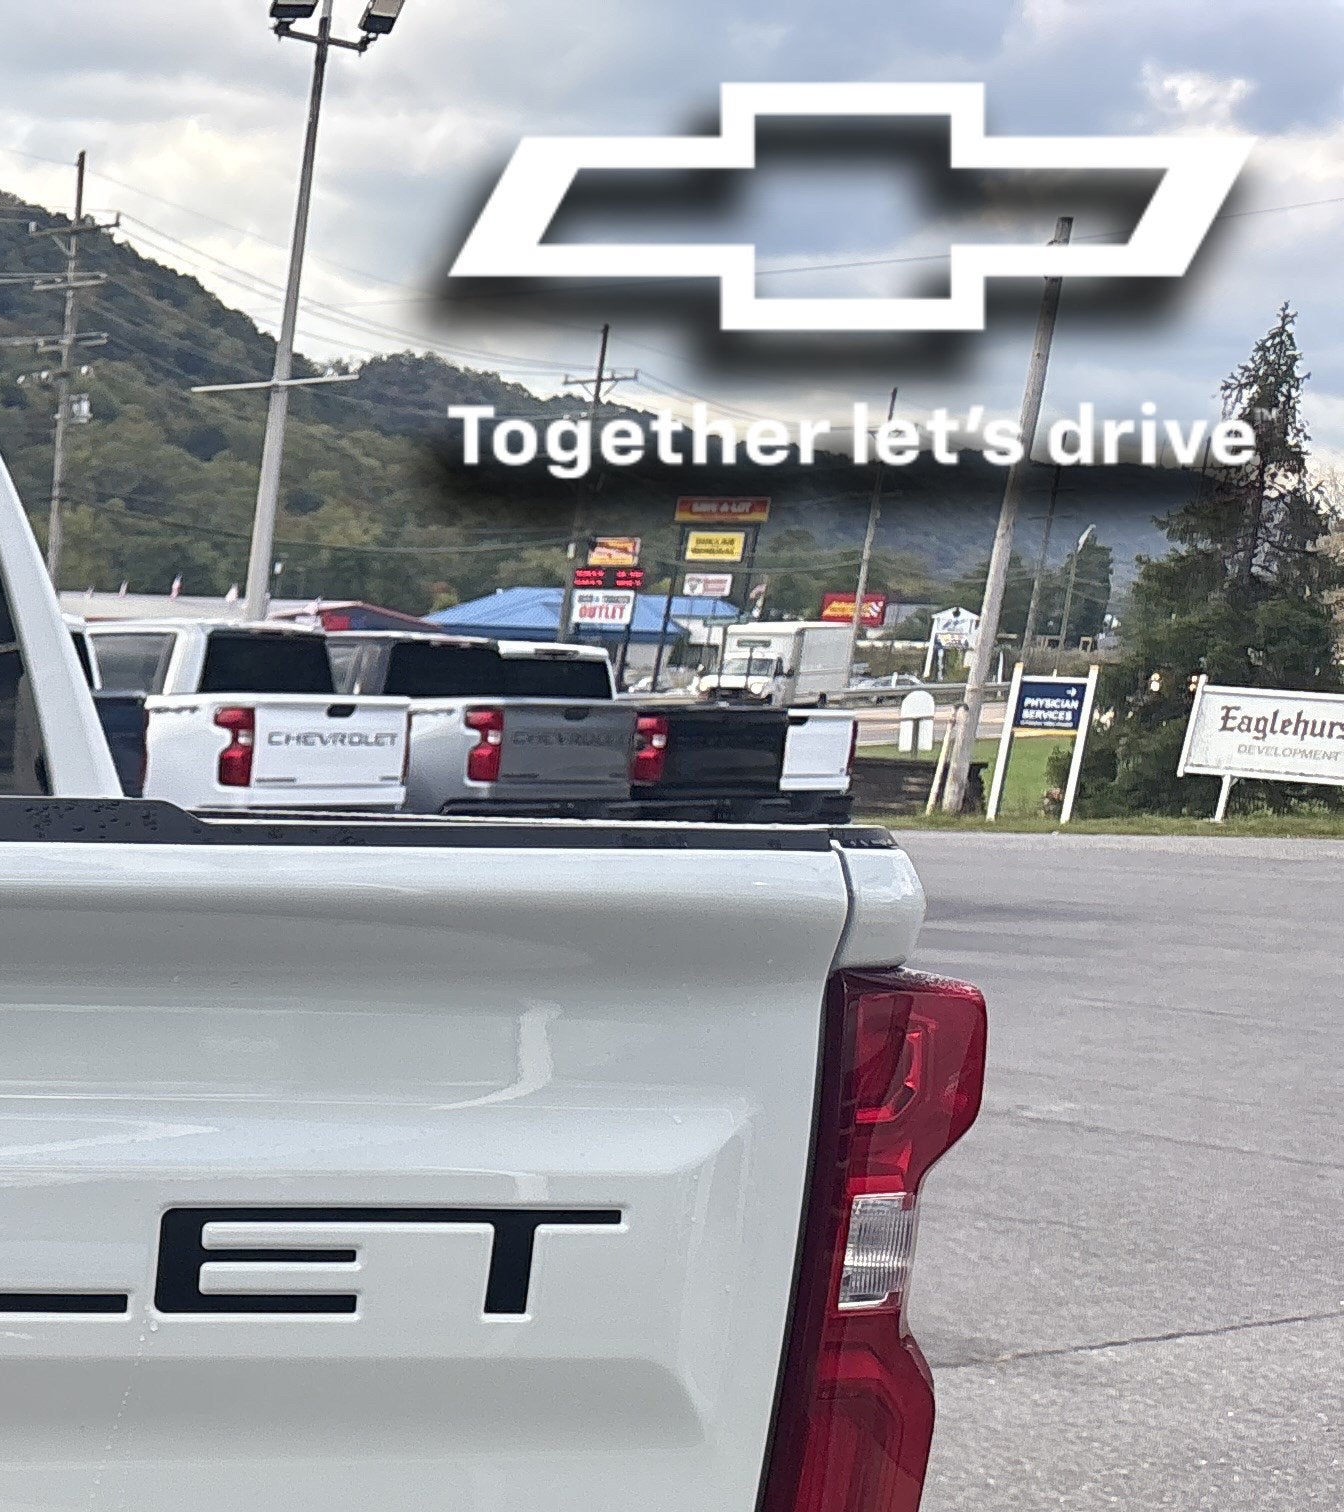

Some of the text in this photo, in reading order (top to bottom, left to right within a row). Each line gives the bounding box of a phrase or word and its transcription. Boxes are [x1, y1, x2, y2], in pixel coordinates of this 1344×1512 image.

[578, 605, 626, 620] OUTLET
[1023, 696, 1079, 711] PHYSICIAN
[267, 731, 399, 747] CHEVROLET
[1237, 743, 1342, 762] DEVELOPMENT
